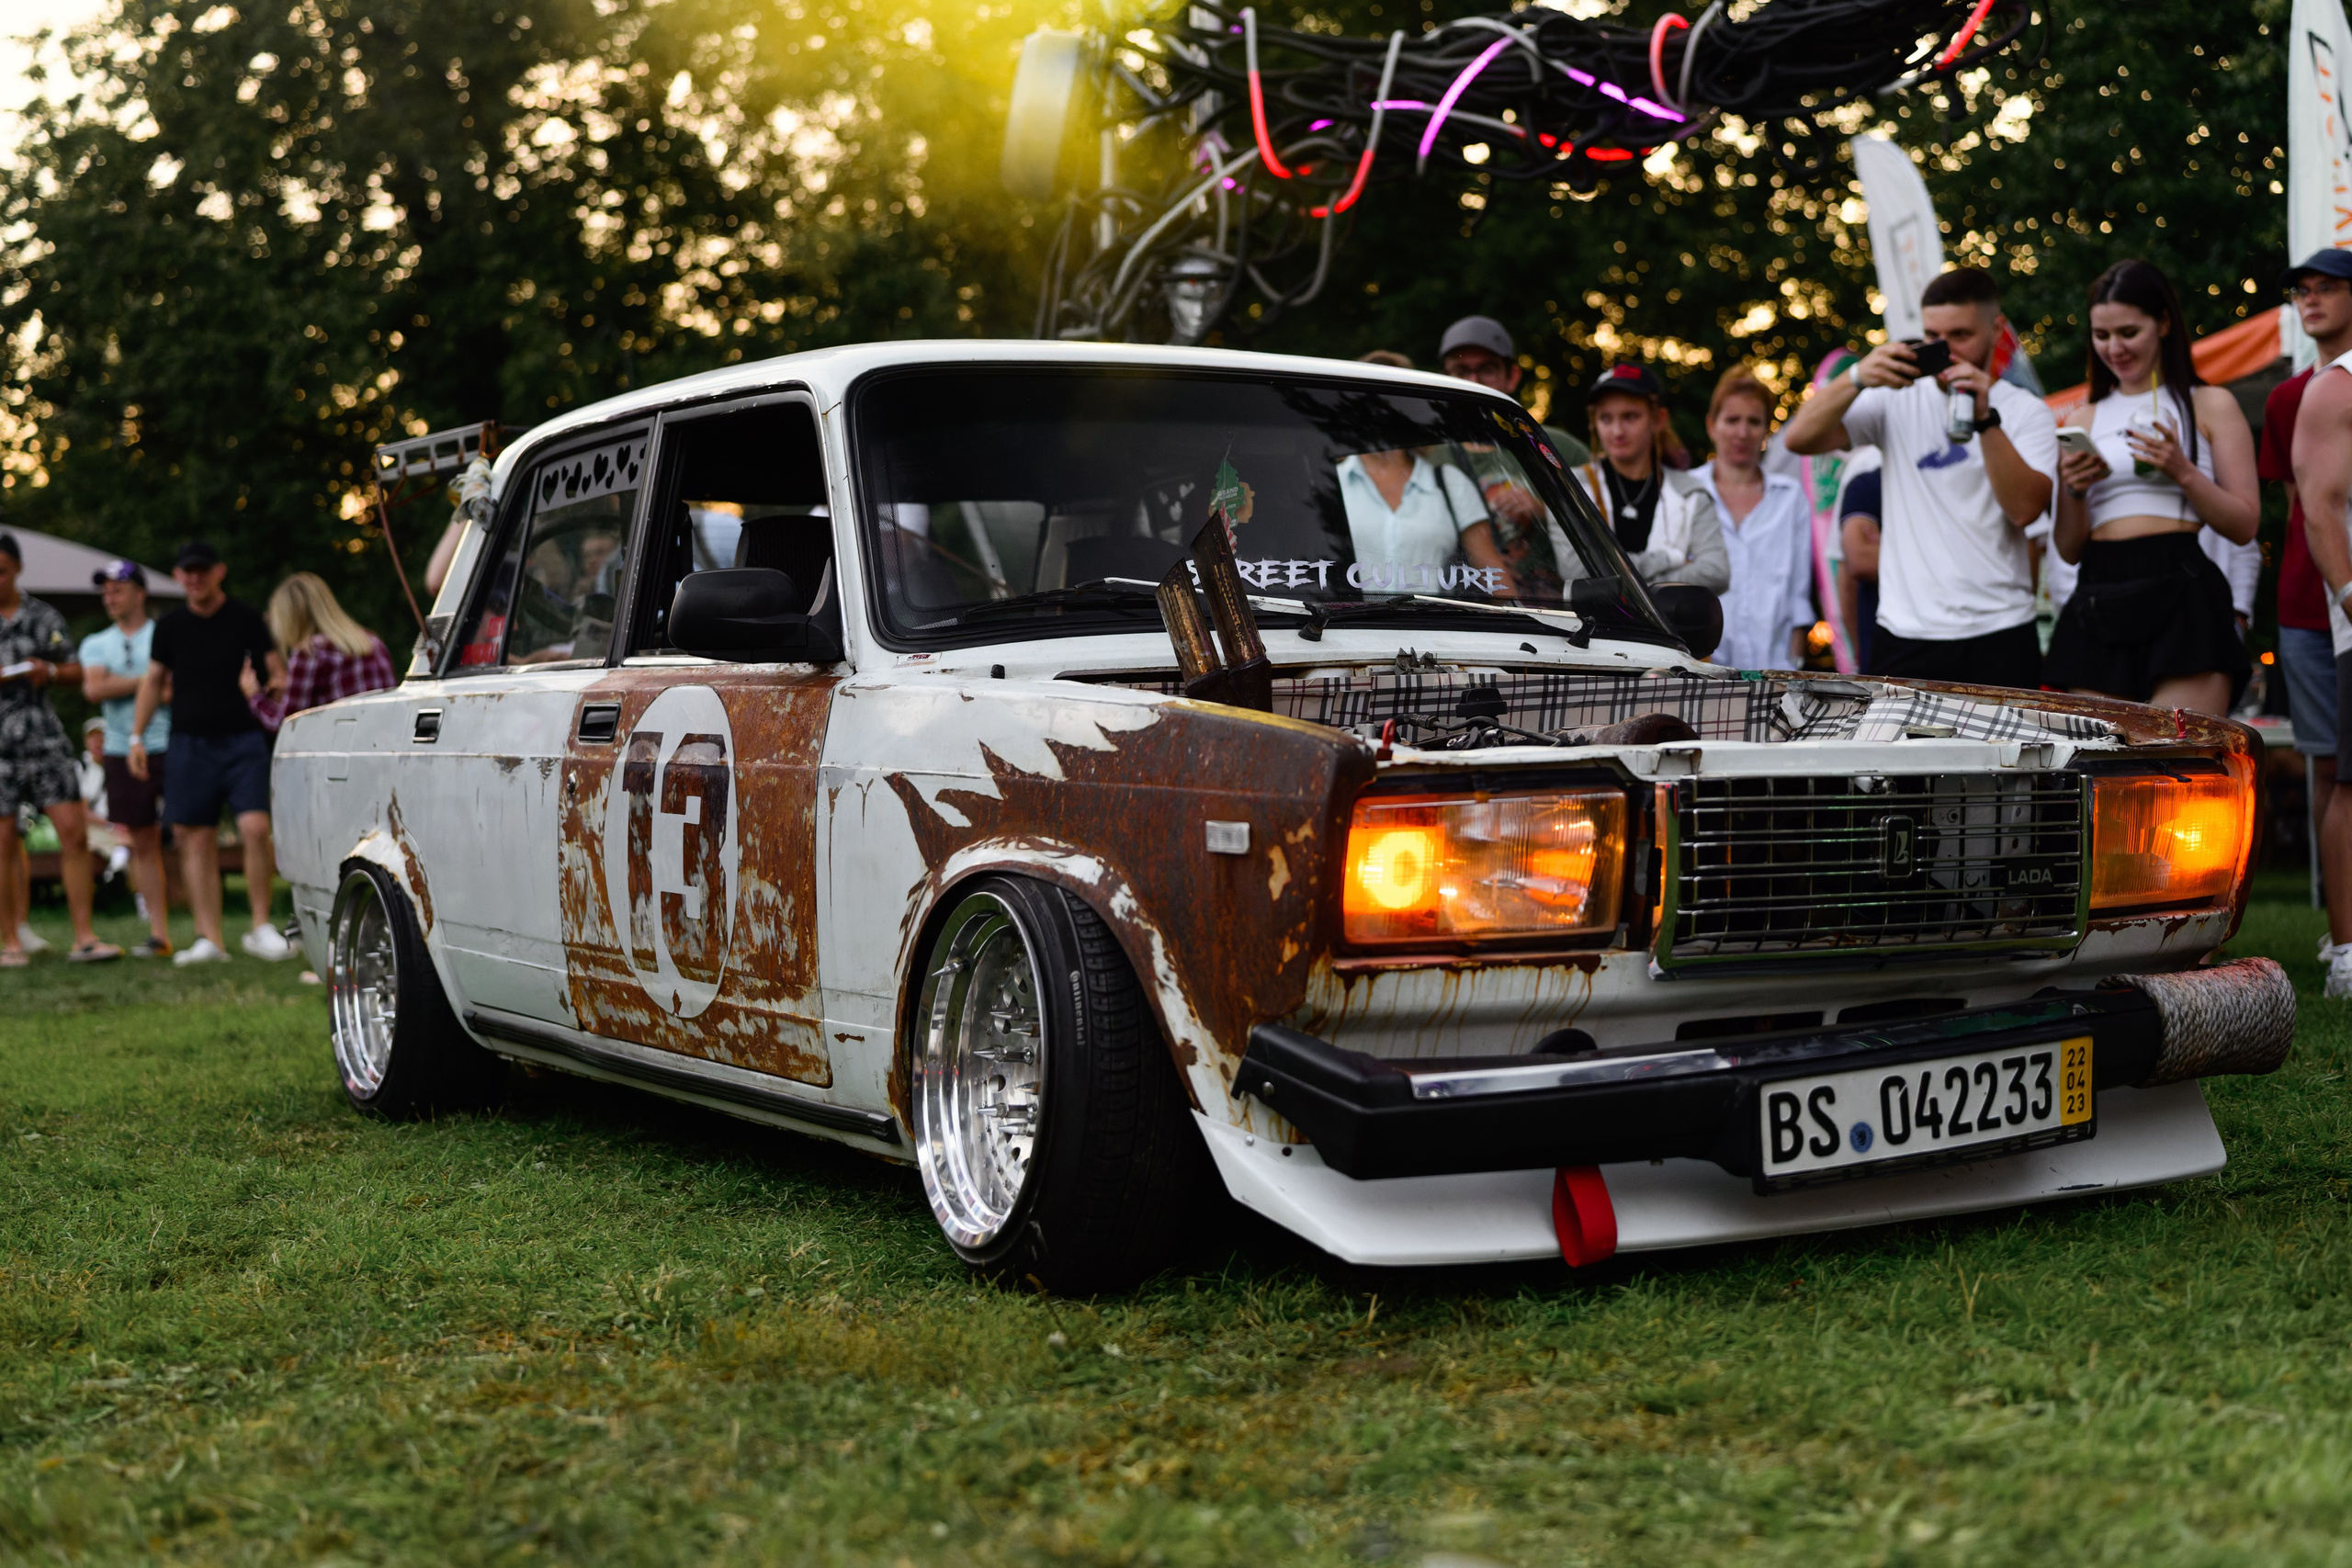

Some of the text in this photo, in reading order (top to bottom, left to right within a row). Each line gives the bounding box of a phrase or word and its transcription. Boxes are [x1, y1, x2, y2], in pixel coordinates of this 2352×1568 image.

[1185, 558, 1510, 596] SREET CULTURE
[622, 731, 731, 985] 13
[2008, 868, 2053, 885] LADA
[2067, 1046, 2086, 1067] 22
[2067, 1068, 2086, 1090] 04
[1768, 1051, 2053, 1164] BS 042233
[2067, 1092, 2086, 1114] 23
